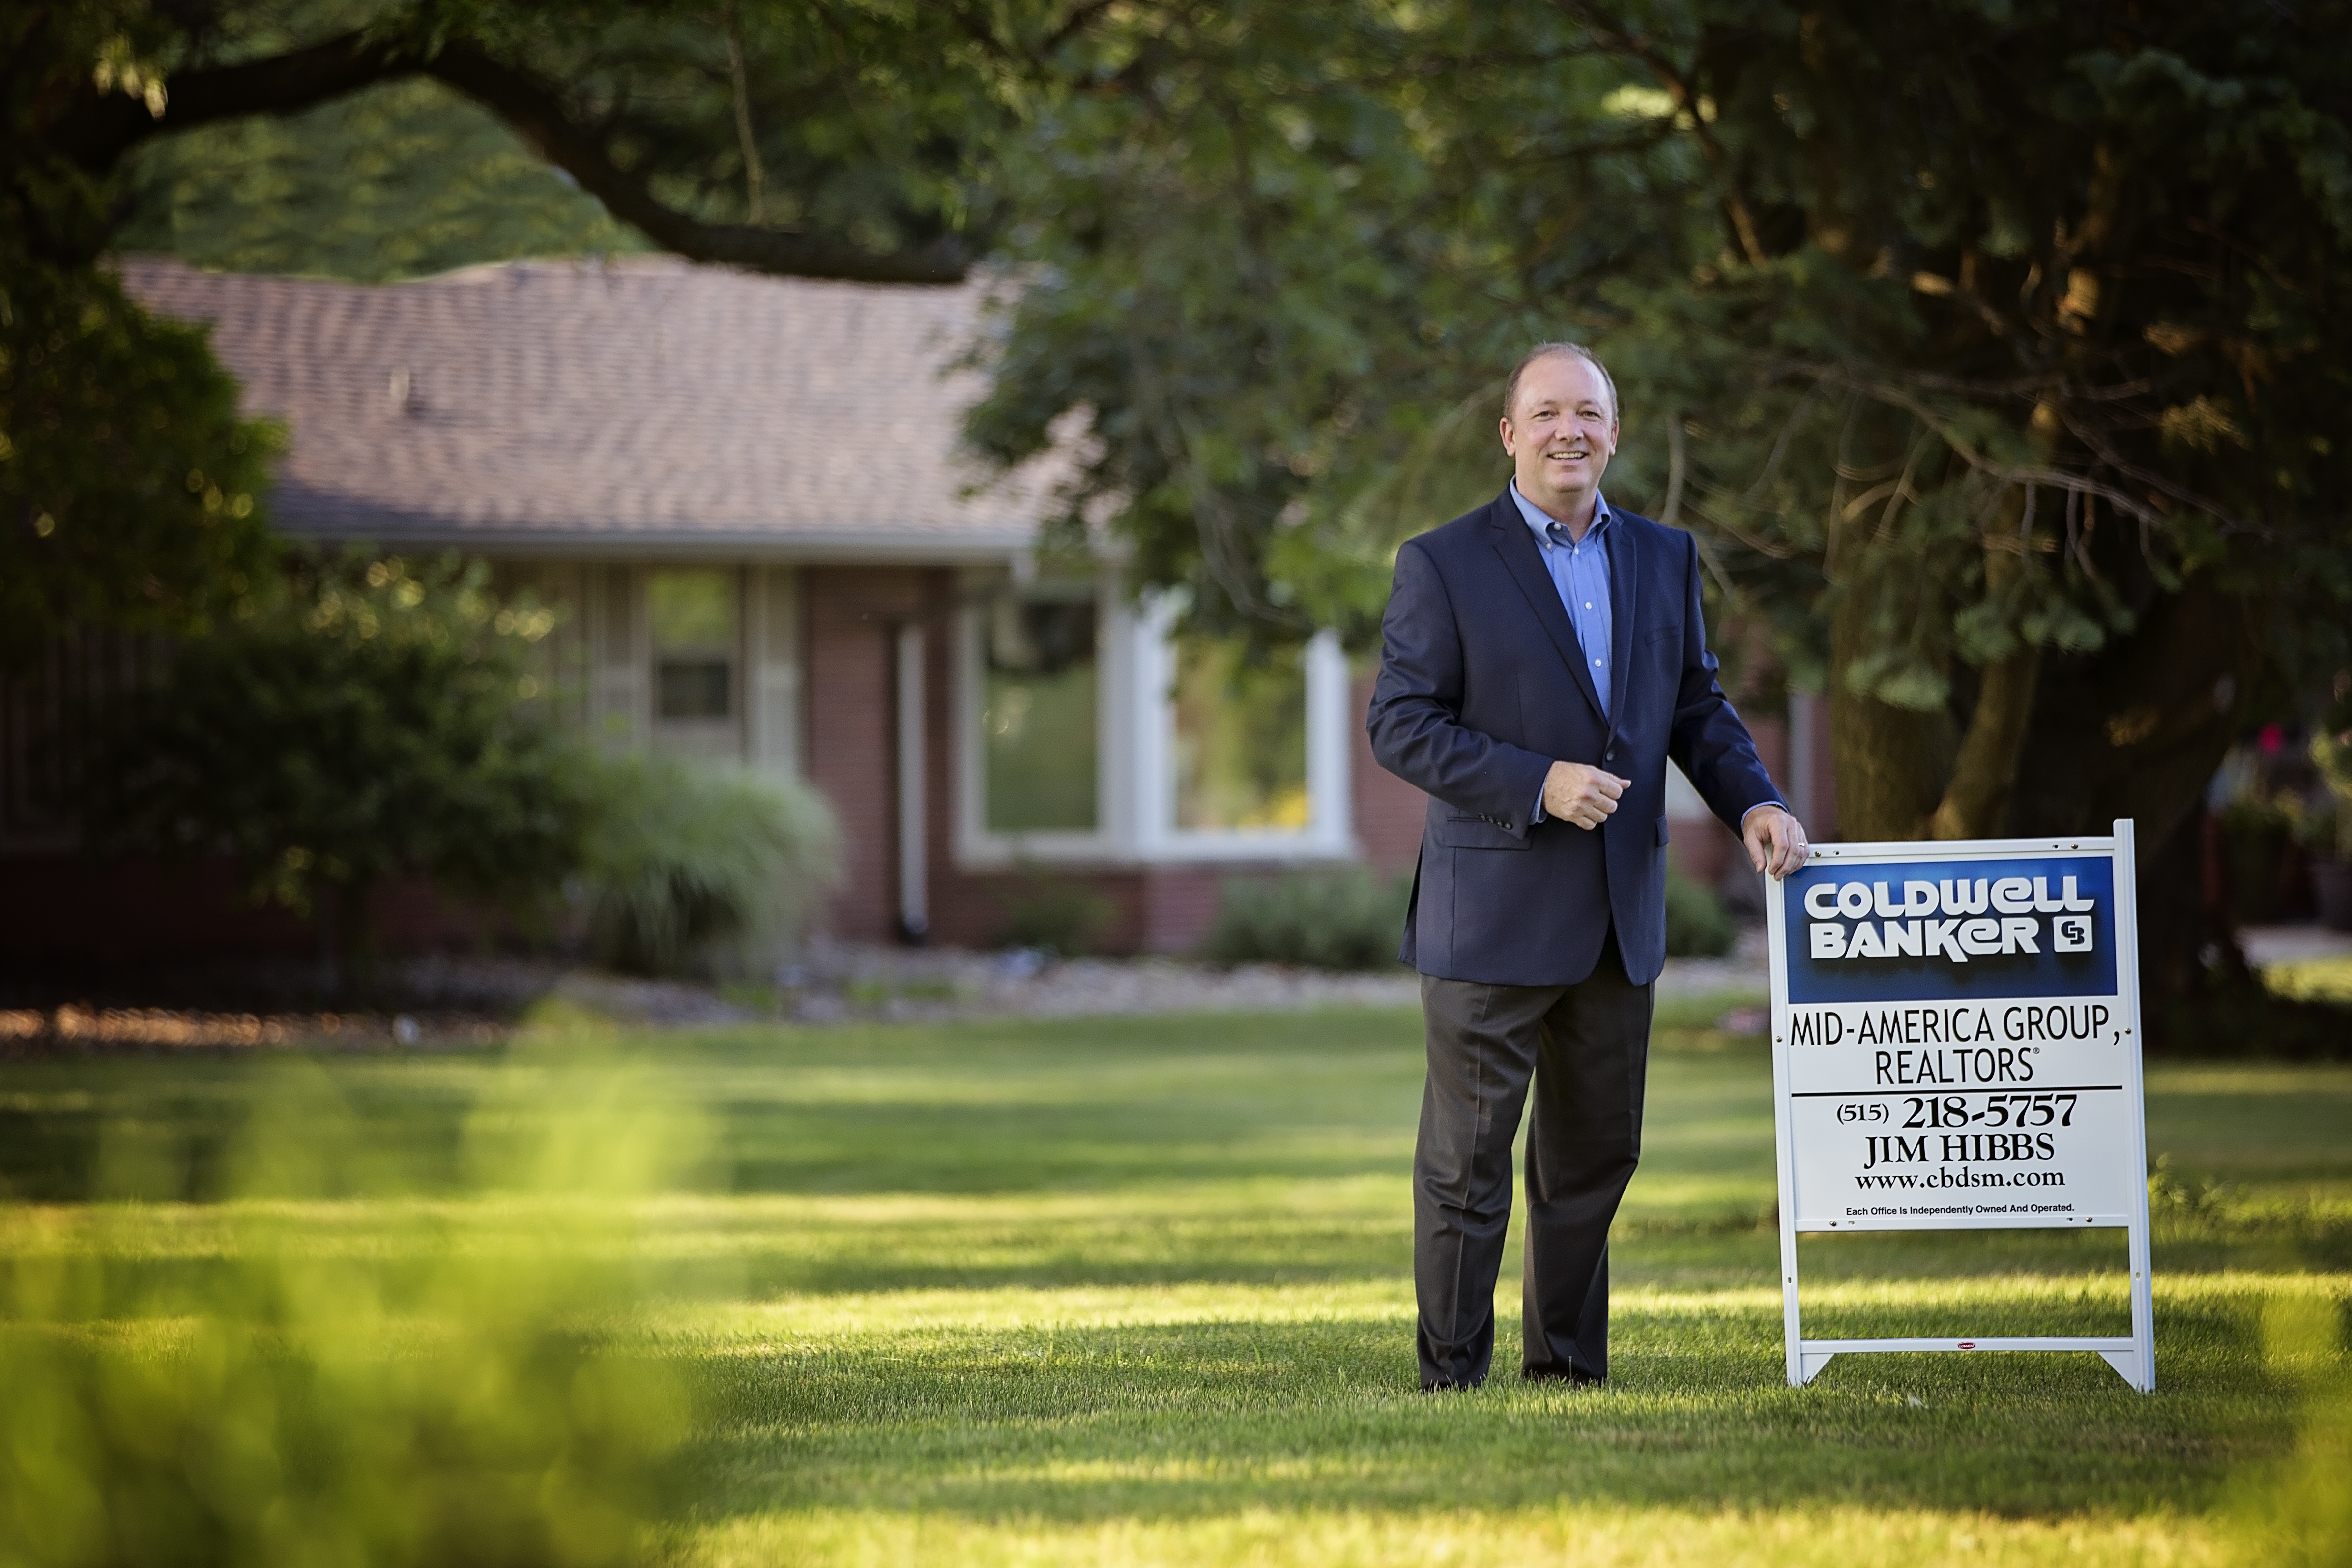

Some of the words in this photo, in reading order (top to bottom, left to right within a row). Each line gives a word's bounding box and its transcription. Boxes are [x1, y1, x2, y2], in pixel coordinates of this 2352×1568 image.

[1790, 1007, 1995, 1046] MID-AMERICA
[2004, 1005, 2120, 1046] GROUP,
[1837, 1103, 1889, 1125] (515)
[1902, 1093, 2077, 1129] 218-5757
[1863, 1135, 1930, 1169] JIM
[1939, 1132, 2055, 1162] HIBBS
[1855, 1166, 2066, 1189] www.cbdsm.com
[1871, 1207, 1897, 1215] Office
[1910, 1205, 1974, 1216] Independently
[1975, 1204, 2007, 1213] Owned
[2009, 1204, 2028, 1213] And
[2031, 1203, 2075, 1214] Operated.
